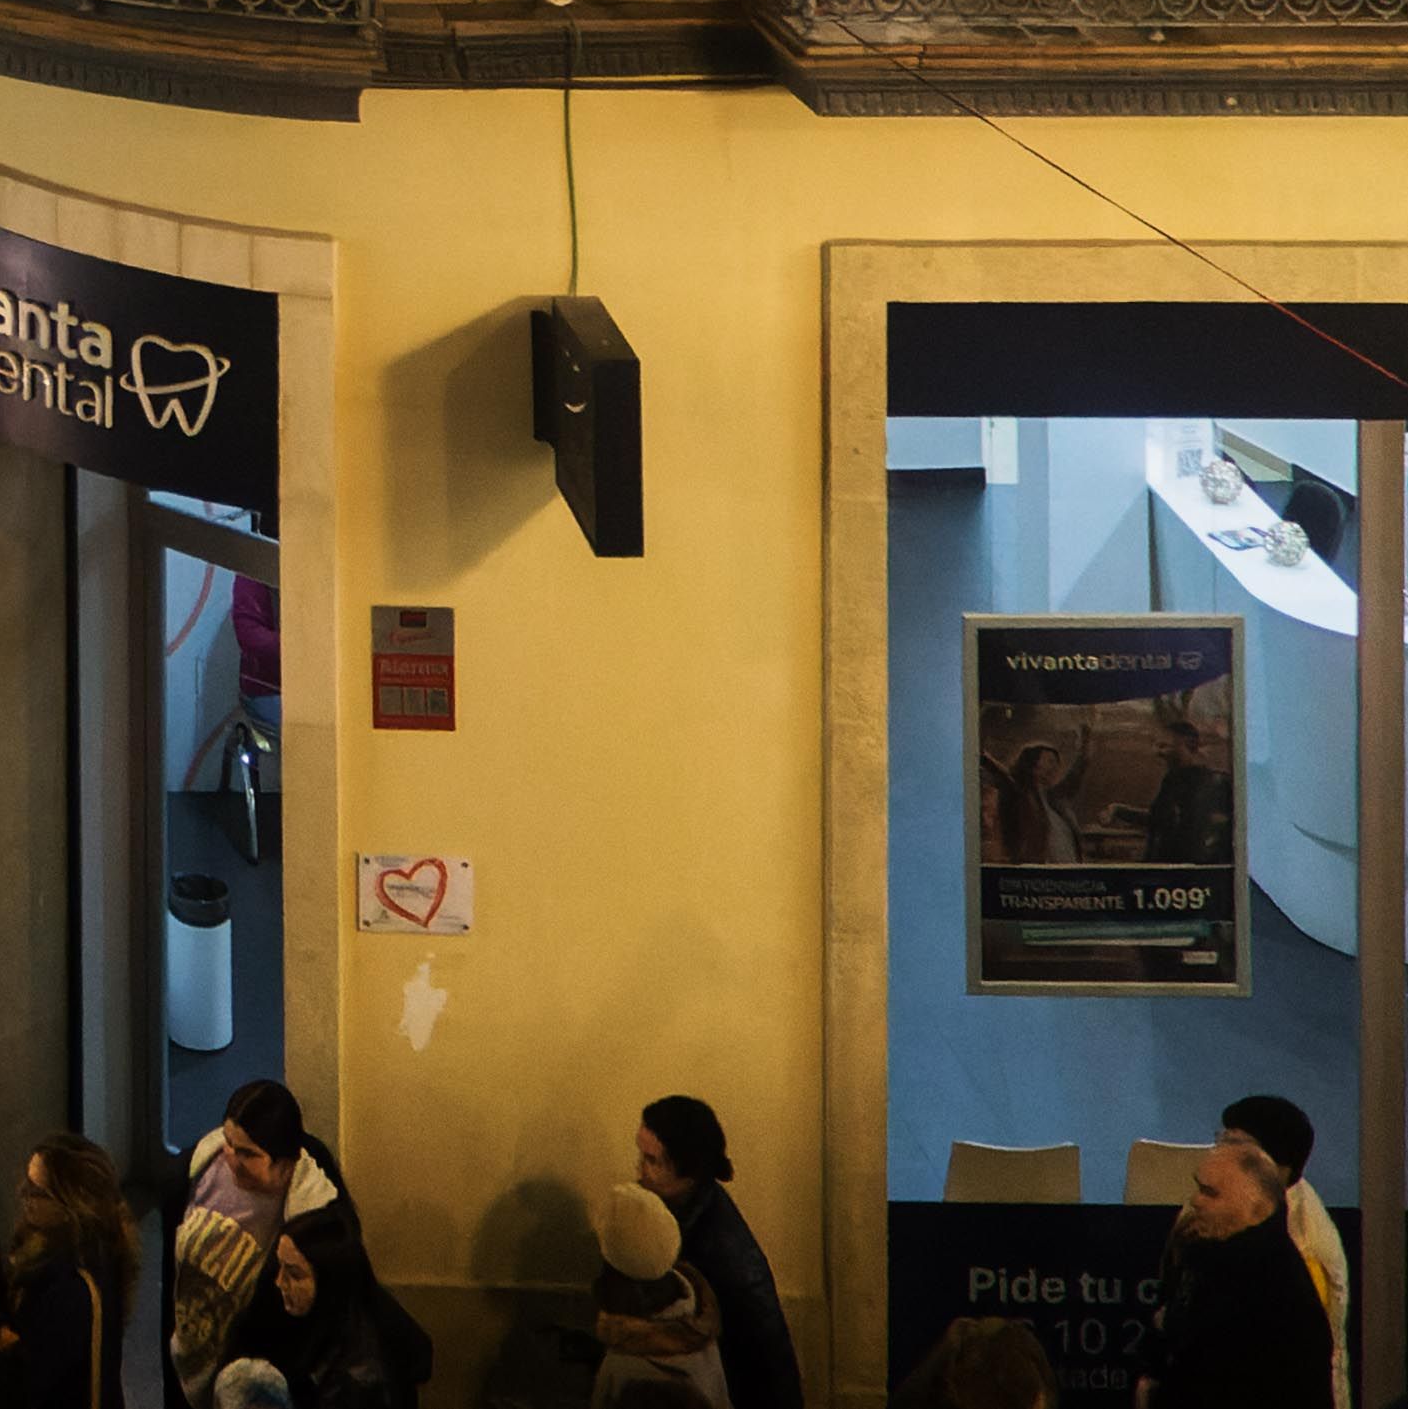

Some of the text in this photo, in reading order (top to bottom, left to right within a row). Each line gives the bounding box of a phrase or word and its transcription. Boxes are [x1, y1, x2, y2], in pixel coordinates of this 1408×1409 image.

[999, 893, 1126, 912] TRANSPARENTE
[967, 1265, 1161, 1305] Pide tu c
[1055, 1317, 1149, 1355] 10 2
